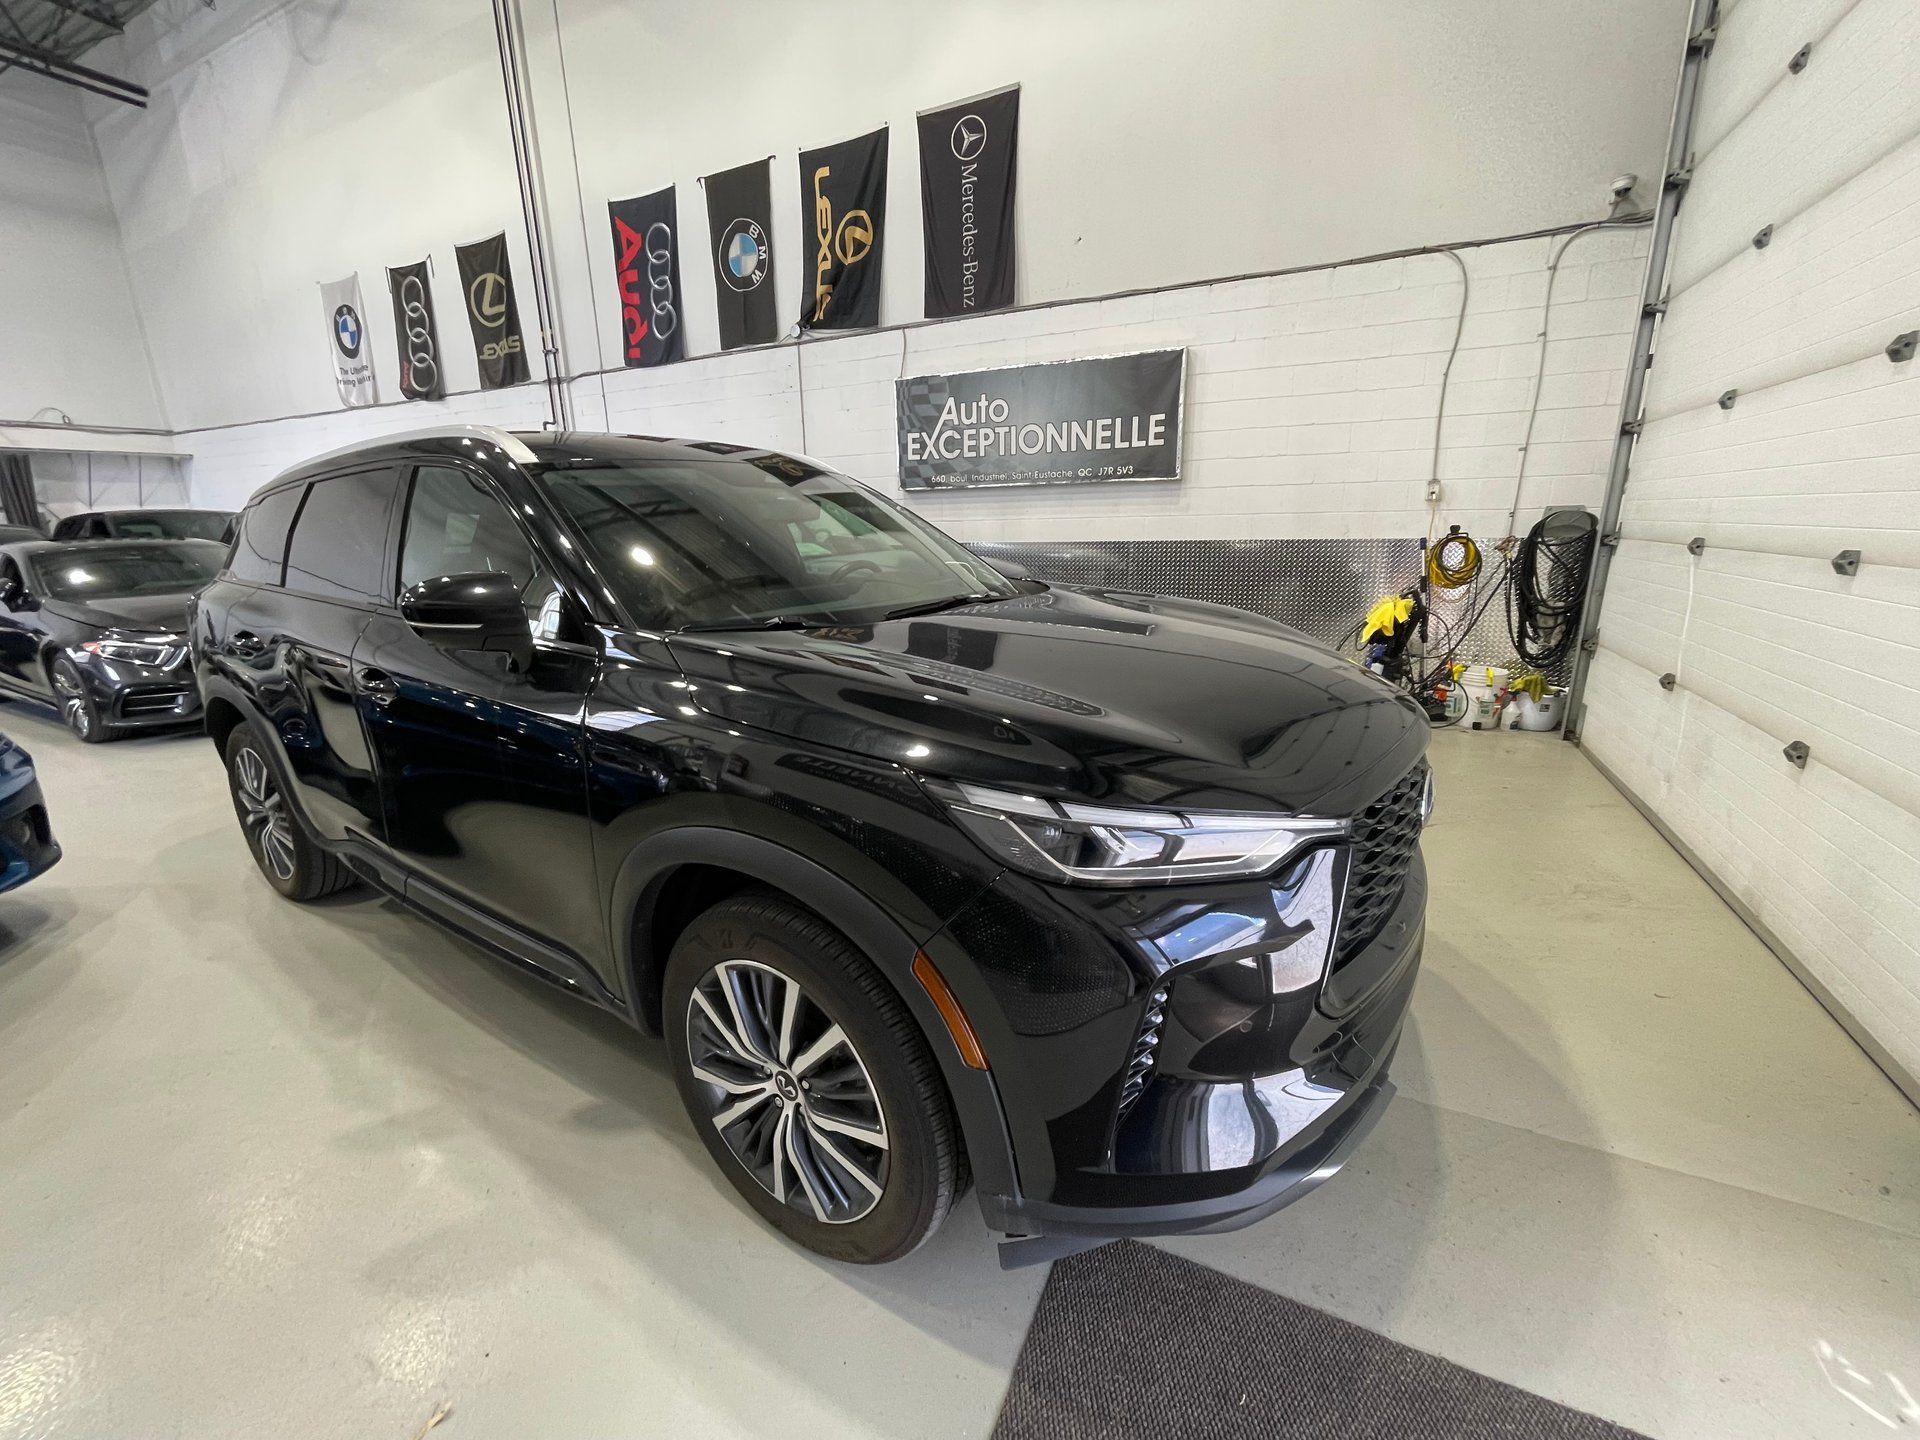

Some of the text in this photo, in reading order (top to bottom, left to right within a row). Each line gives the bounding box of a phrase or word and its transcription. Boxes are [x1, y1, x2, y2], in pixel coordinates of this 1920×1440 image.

[748, 223, 768, 285] BMW
[960, 162, 978, 308] Mercedes-Benz
[480, 334, 521, 360] EXS
[938, 393, 1010, 427] Auto
[906, 412, 1167, 462] EXCEPTIONNELLE
[1077, 467, 1094, 477] QC
[1097, 466, 1114, 477] J7R
[1116, 465, 1135, 475] 5V3
